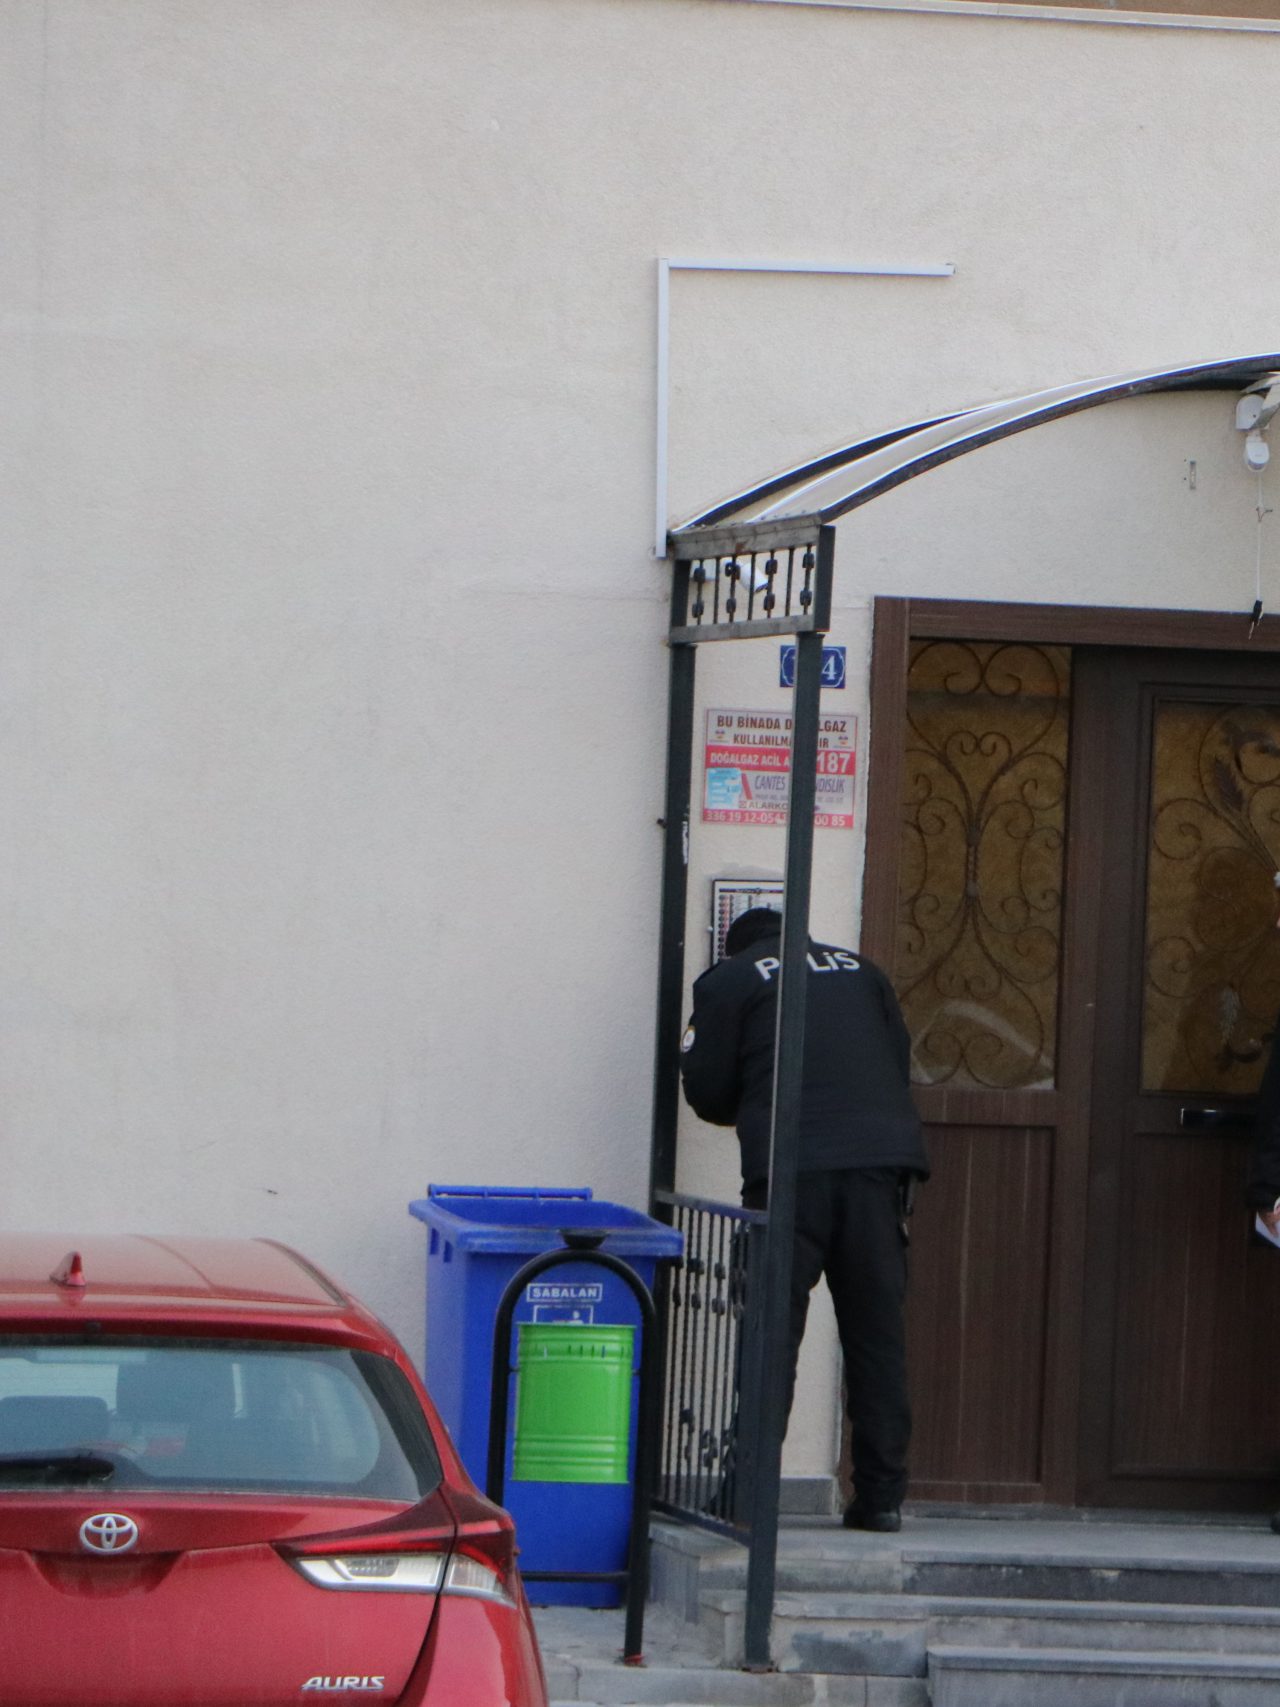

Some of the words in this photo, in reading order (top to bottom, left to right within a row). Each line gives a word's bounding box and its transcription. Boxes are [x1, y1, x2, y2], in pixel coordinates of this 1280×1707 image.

[716, 714, 733, 728] BU
[737, 713, 781, 730] BİNADA
[710, 751, 759, 765] DOĞALGAZ
[816, 752, 850, 773] 187
[729, 811, 742, 822] 19
[831, 815, 846, 826] 85
[754, 951, 860, 981] PLİS
[532, 1287, 598, 1298] SABALAN
[301, 1676, 385, 1691] AURIS
